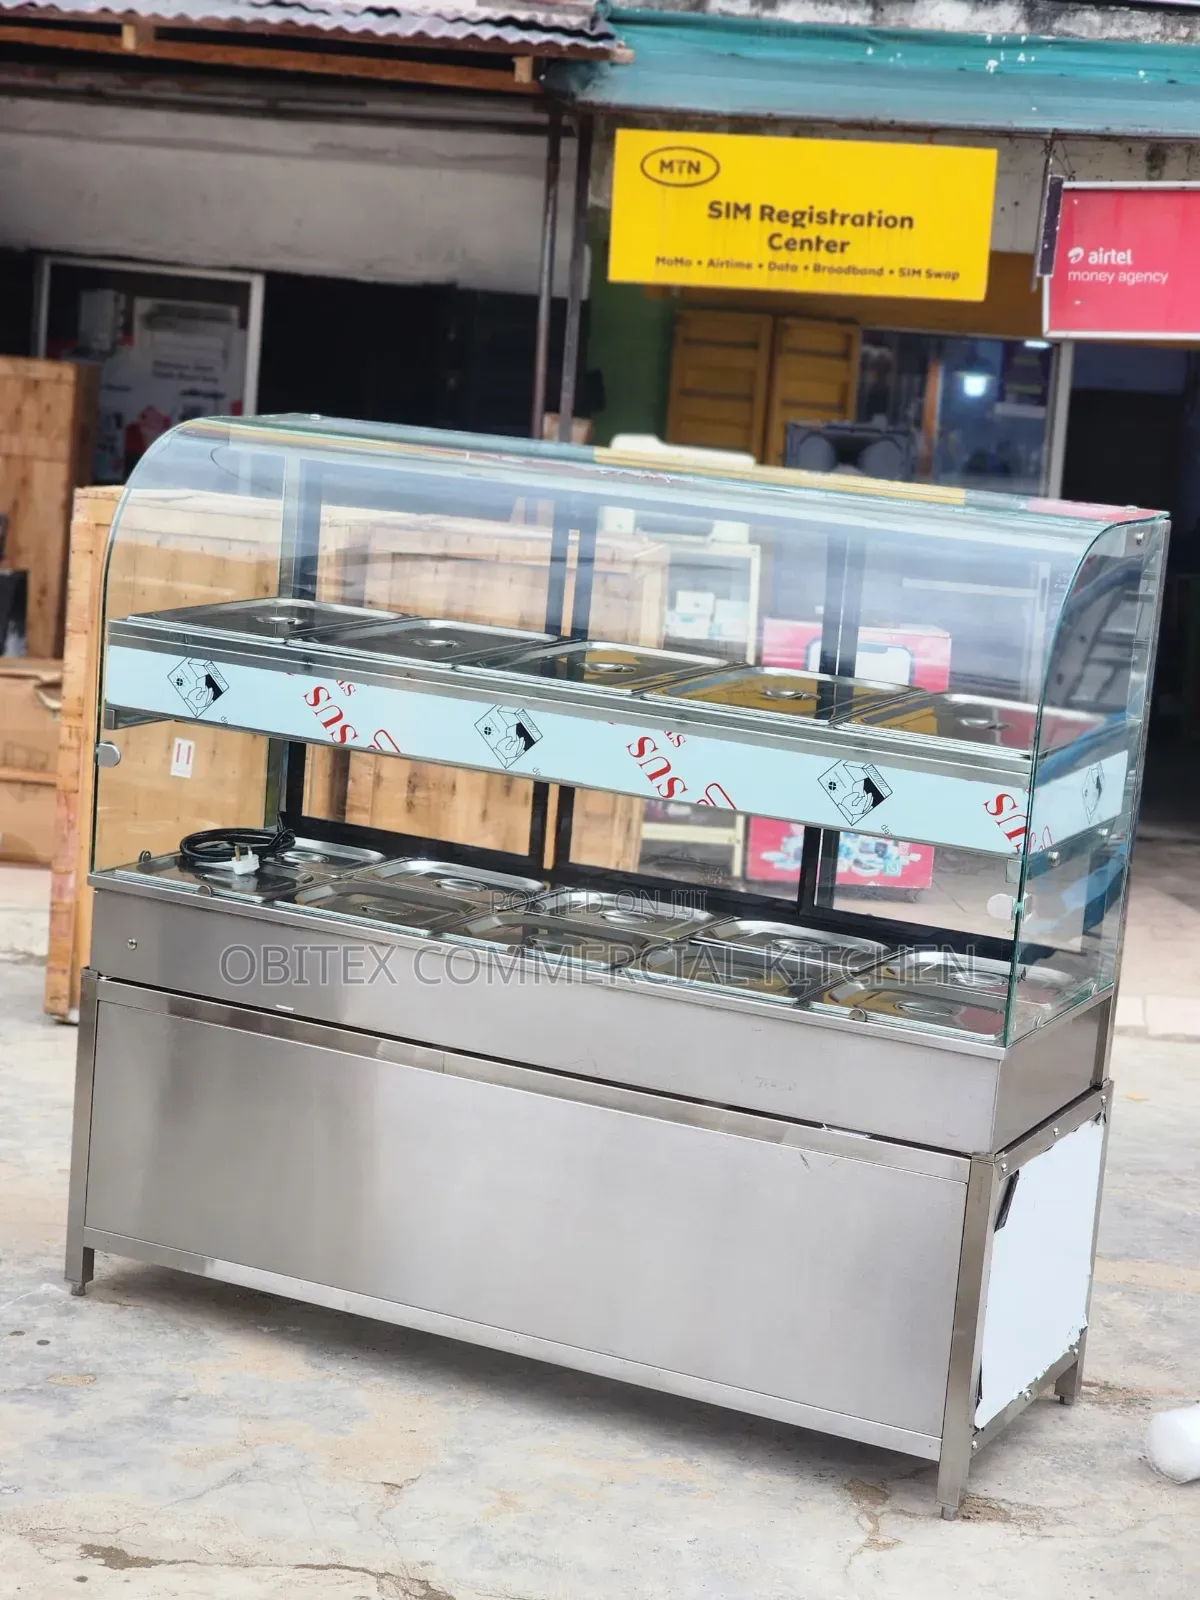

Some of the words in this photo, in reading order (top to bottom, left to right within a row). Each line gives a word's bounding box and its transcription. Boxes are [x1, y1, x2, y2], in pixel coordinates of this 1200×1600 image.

[659, 159, 702, 175] MTN
[707, 200, 752, 221] SIM
[759, 204, 914, 230] Registration
[767, 232, 851, 254] Center
[1087, 247, 1133, 265] airtel
[655, 255, 693, 268] MoMo
[707, 258, 753, 270] Airtime
[767, 261, 799, 273] Data
[812, 262, 885, 277] Broadband
[898, 267, 922, 279] SIM
[925, 268, 960, 282] Swap
[1067, 269, 1115, 285] money
[1117, 271, 1169, 286] agency
